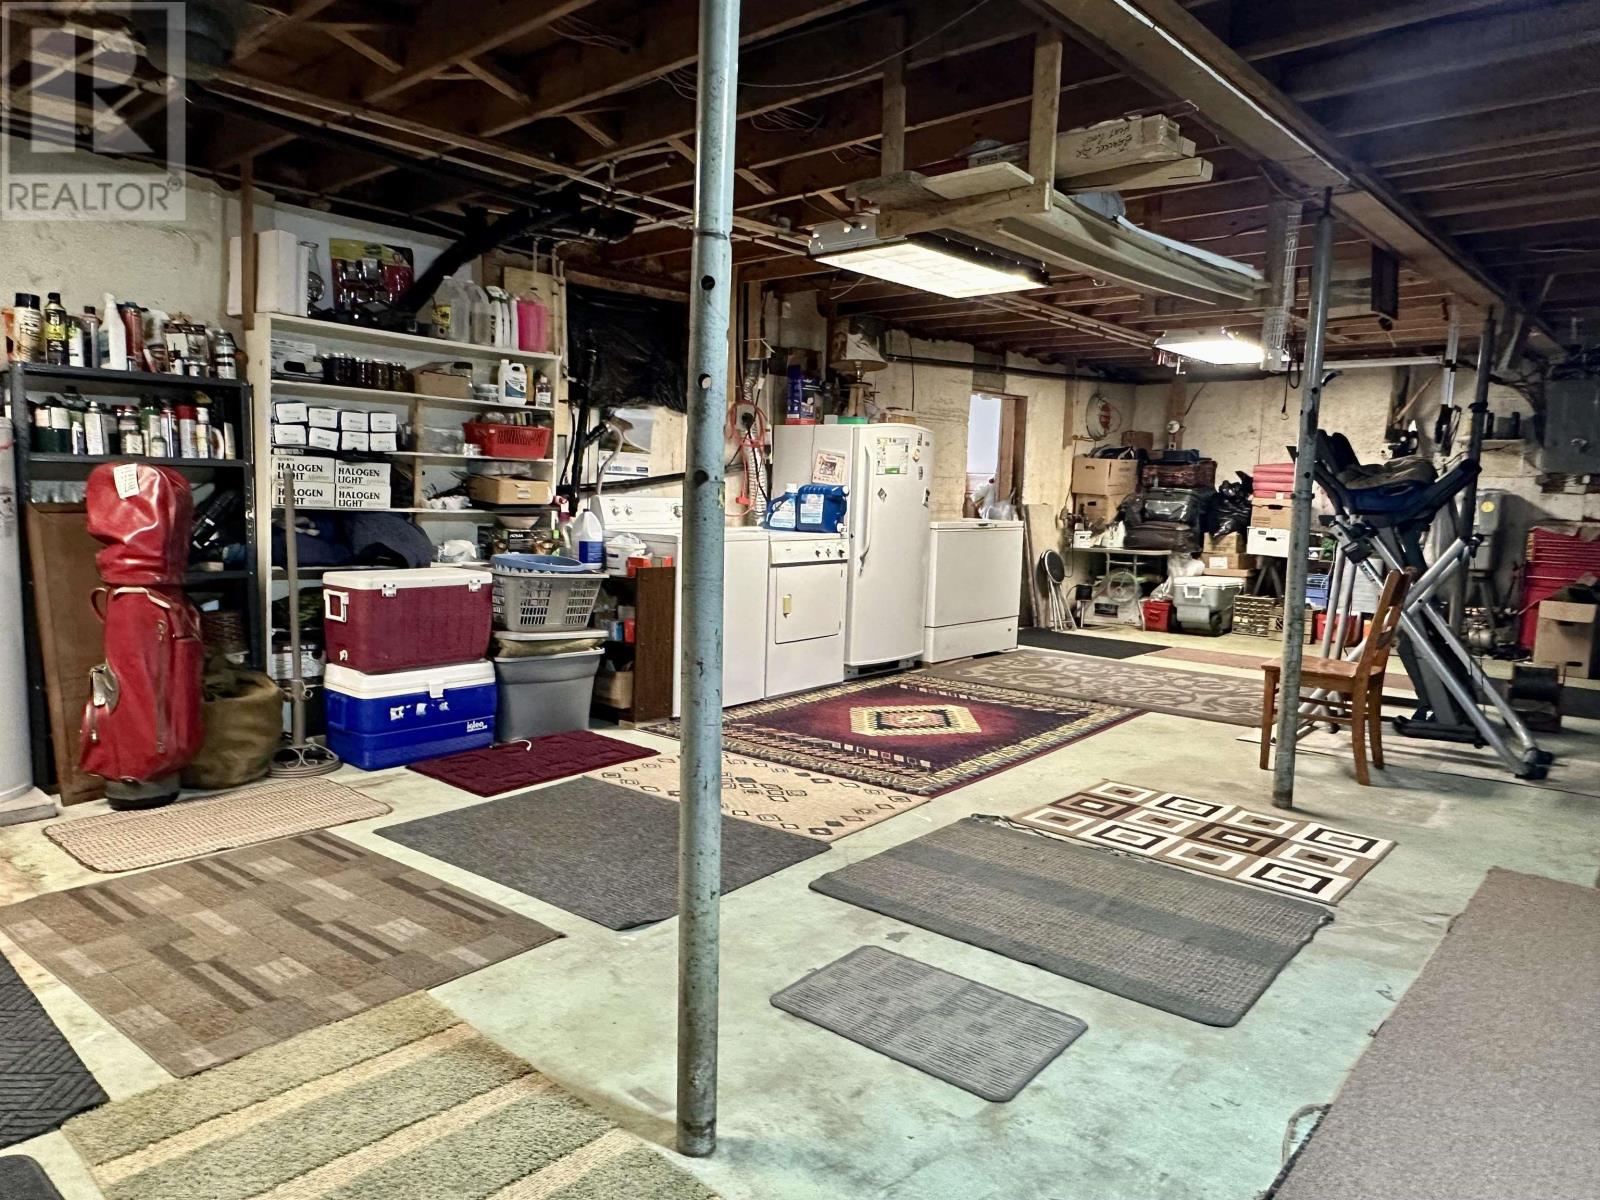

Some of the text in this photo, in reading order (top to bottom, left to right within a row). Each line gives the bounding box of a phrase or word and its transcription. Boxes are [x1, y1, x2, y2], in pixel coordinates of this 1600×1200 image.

[338, 467, 380, 477] HALOGEN
[338, 476, 363, 484] LIGHT
[338, 491, 380, 500] HALOGEN
[338, 499, 363, 507] LIGHT
